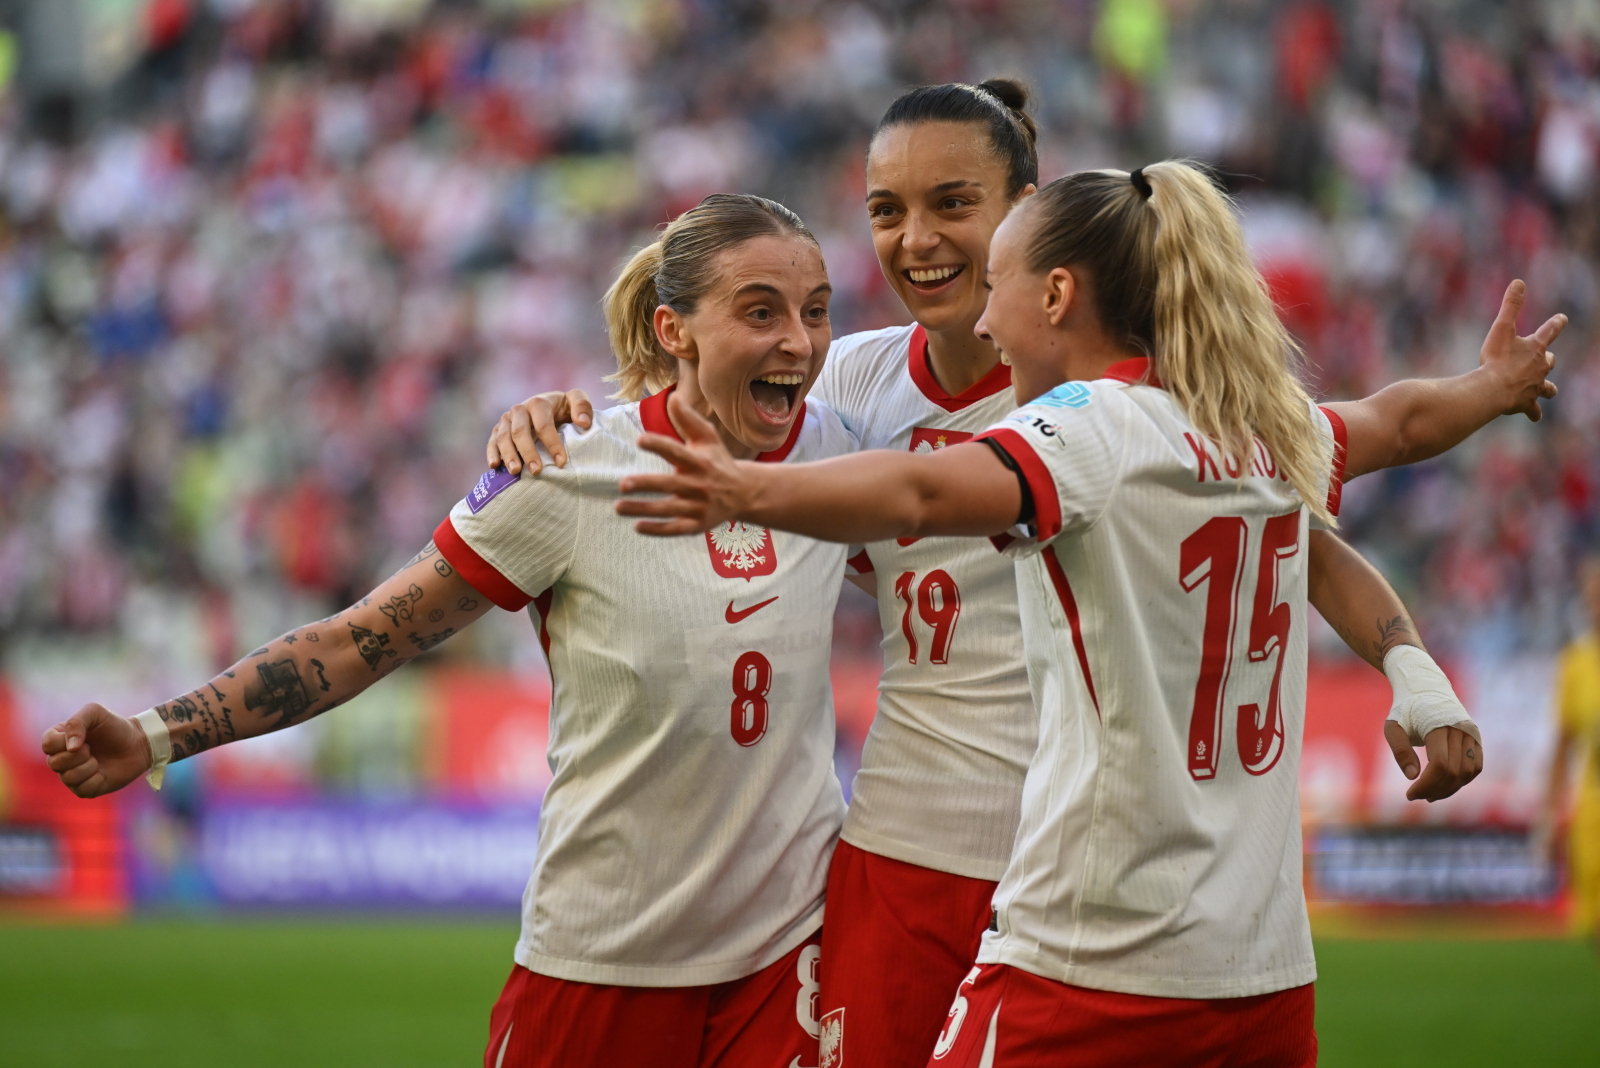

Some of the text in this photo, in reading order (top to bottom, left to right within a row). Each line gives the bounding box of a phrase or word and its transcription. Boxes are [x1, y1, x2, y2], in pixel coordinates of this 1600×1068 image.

[895, 569, 961, 665] 19
[1179, 510, 1300, 781] 15
[730, 650, 772, 747] 8
